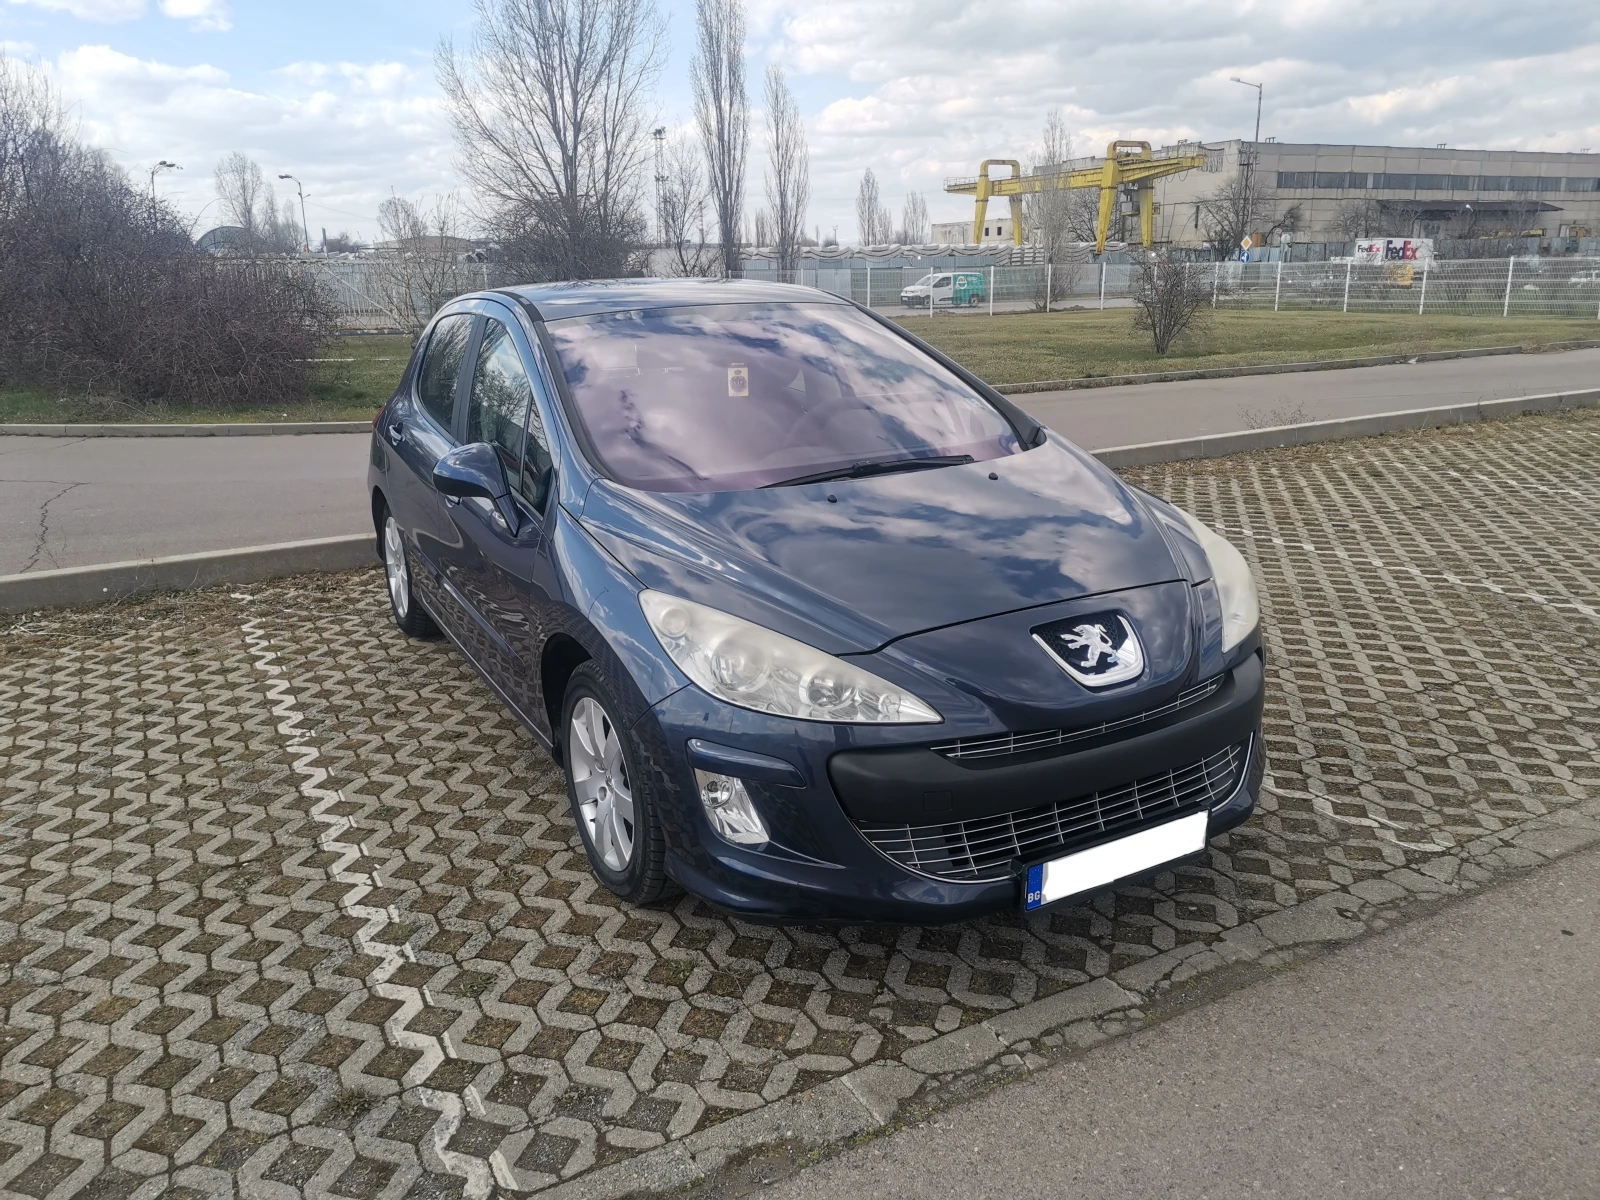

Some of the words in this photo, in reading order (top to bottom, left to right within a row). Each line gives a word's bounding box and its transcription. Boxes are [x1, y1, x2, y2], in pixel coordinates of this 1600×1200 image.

[1357, 244, 1380, 253] FedEx
[1385, 240, 1418, 260] FedEx
[1027, 890, 1041, 903] BG
